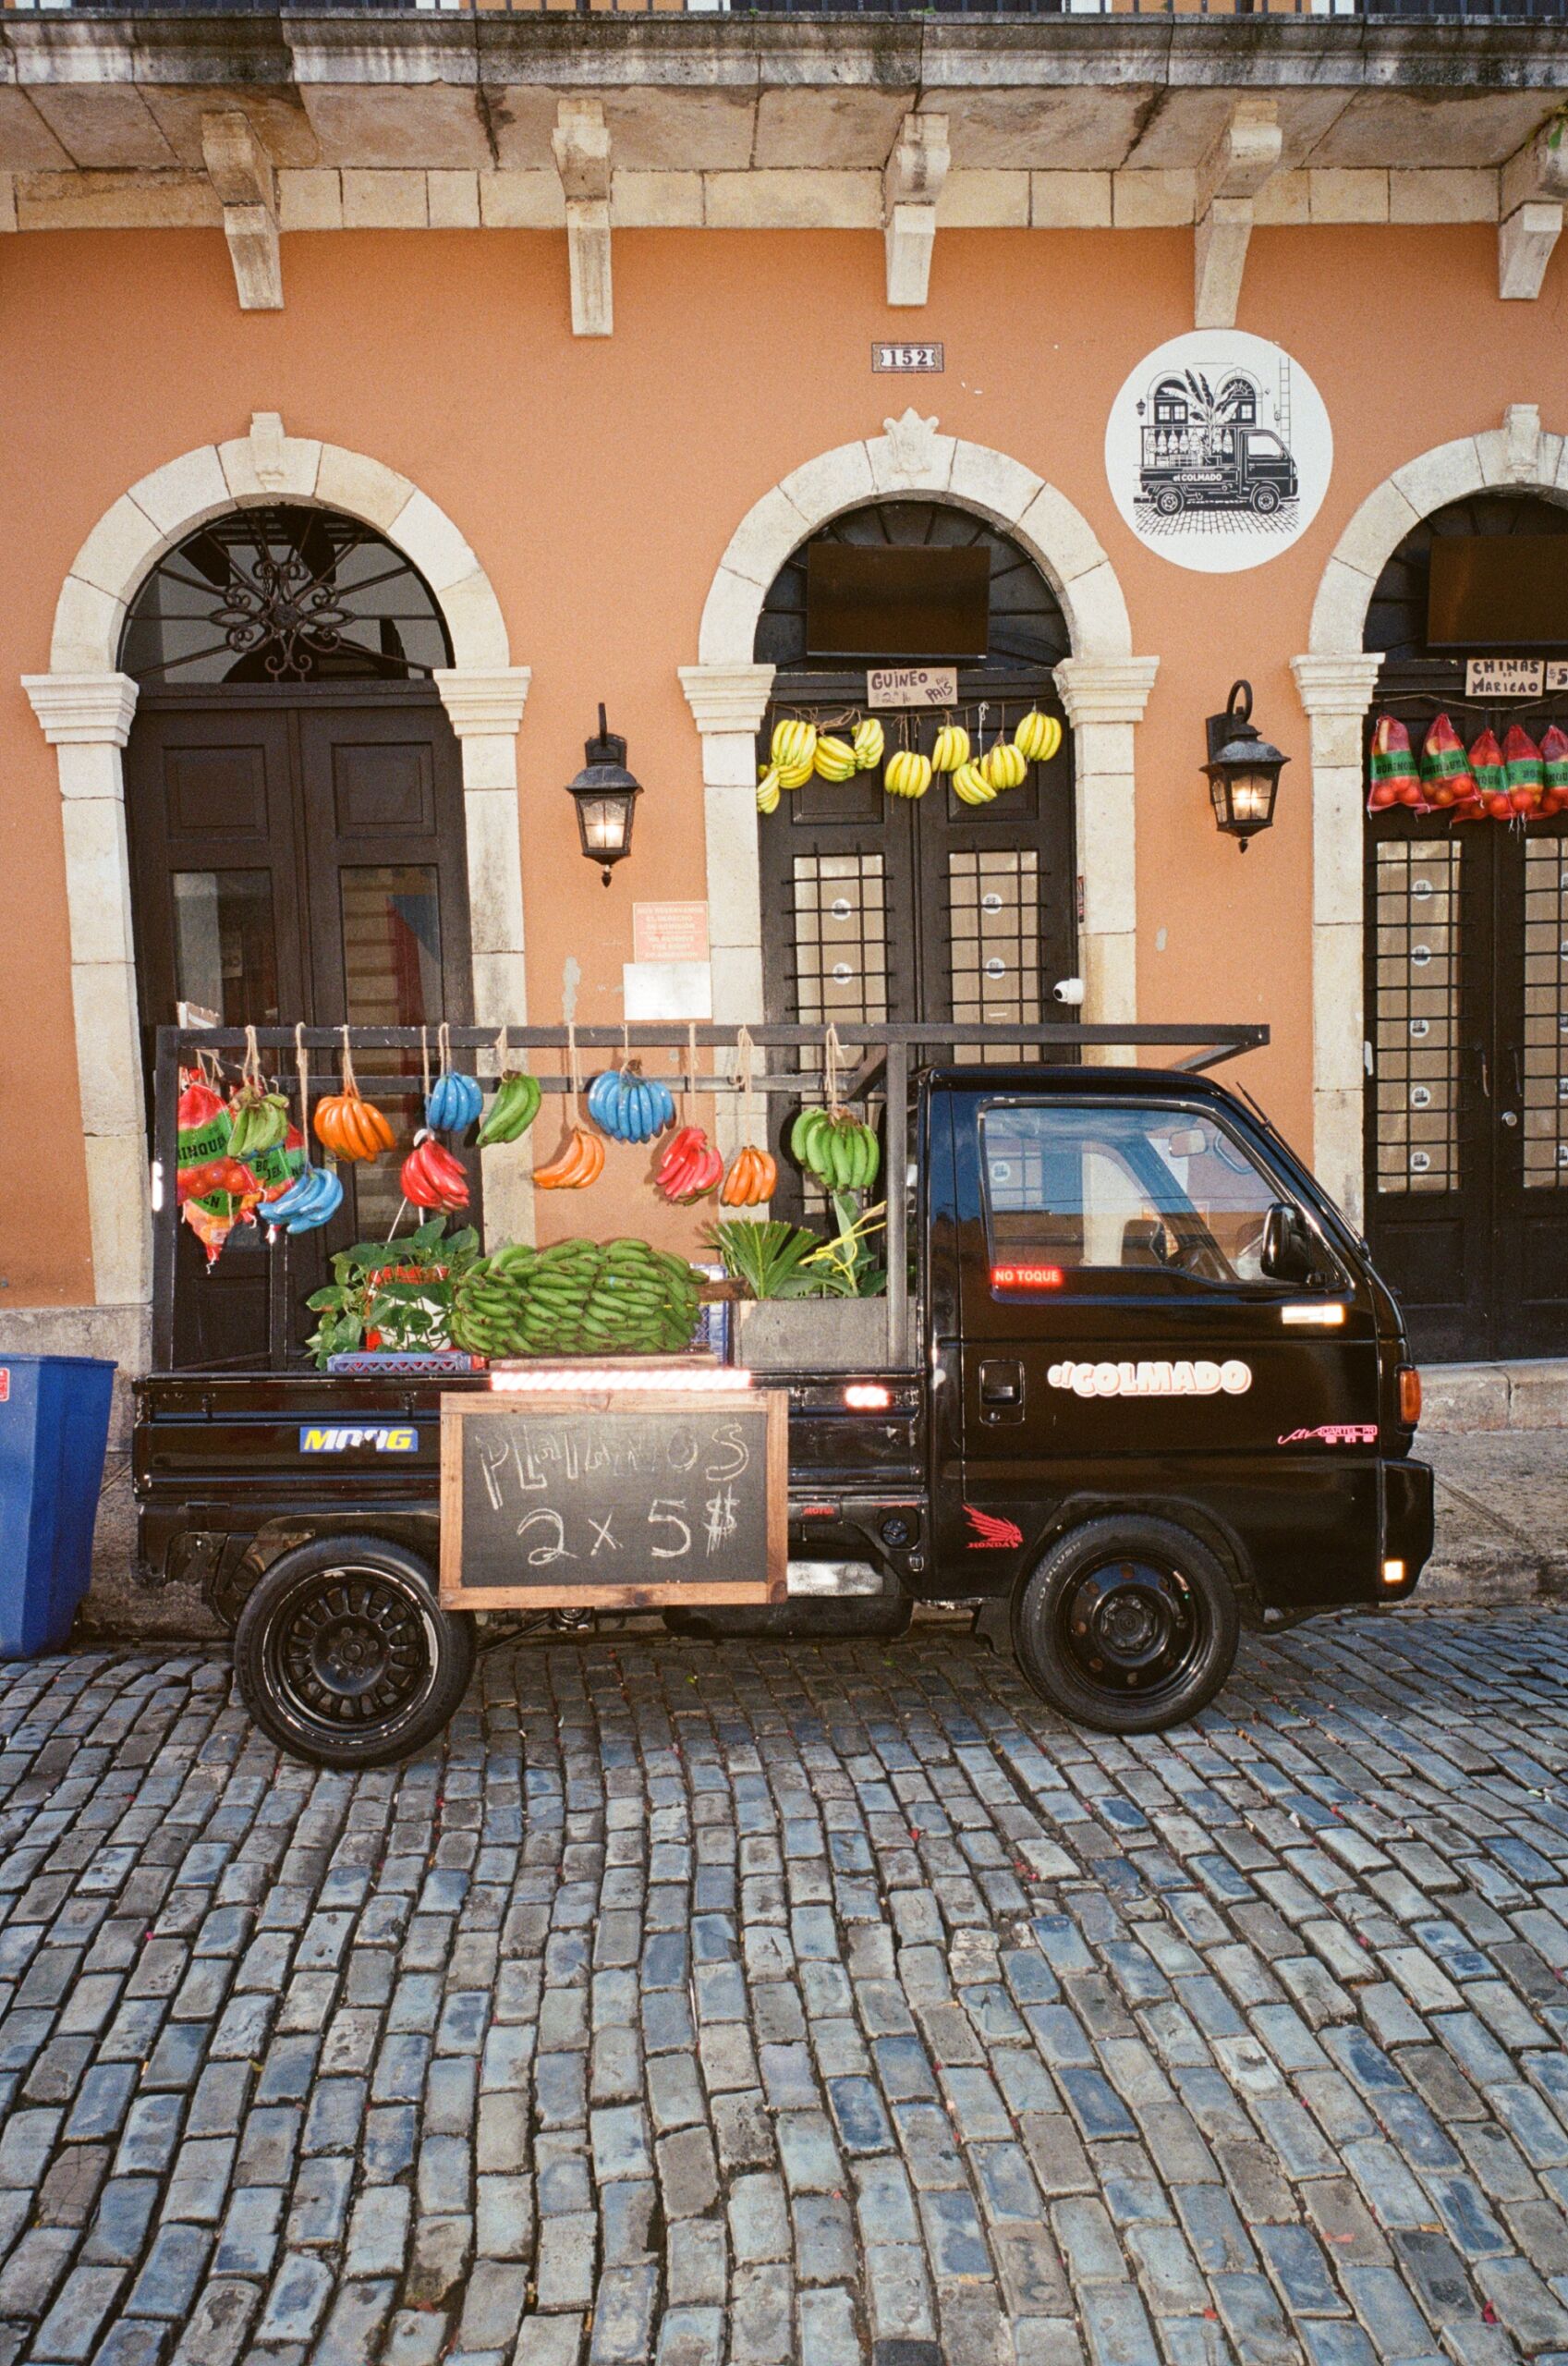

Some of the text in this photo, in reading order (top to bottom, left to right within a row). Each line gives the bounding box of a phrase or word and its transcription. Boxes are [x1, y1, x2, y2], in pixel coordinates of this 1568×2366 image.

[890, 350, 928, 366] 152
[1182, 473, 1222, 482] COLMADO
[1472, 660, 1539, 675] CHINAS
[925, 680, 954, 704] PAIS
[1472, 677, 1538, 694] MARICAO
[995, 1270, 1059, 1282] NO TOQUE
[1072, 1360, 1252, 1397] COLMADO
[517, 1508, 578, 1566] 2
